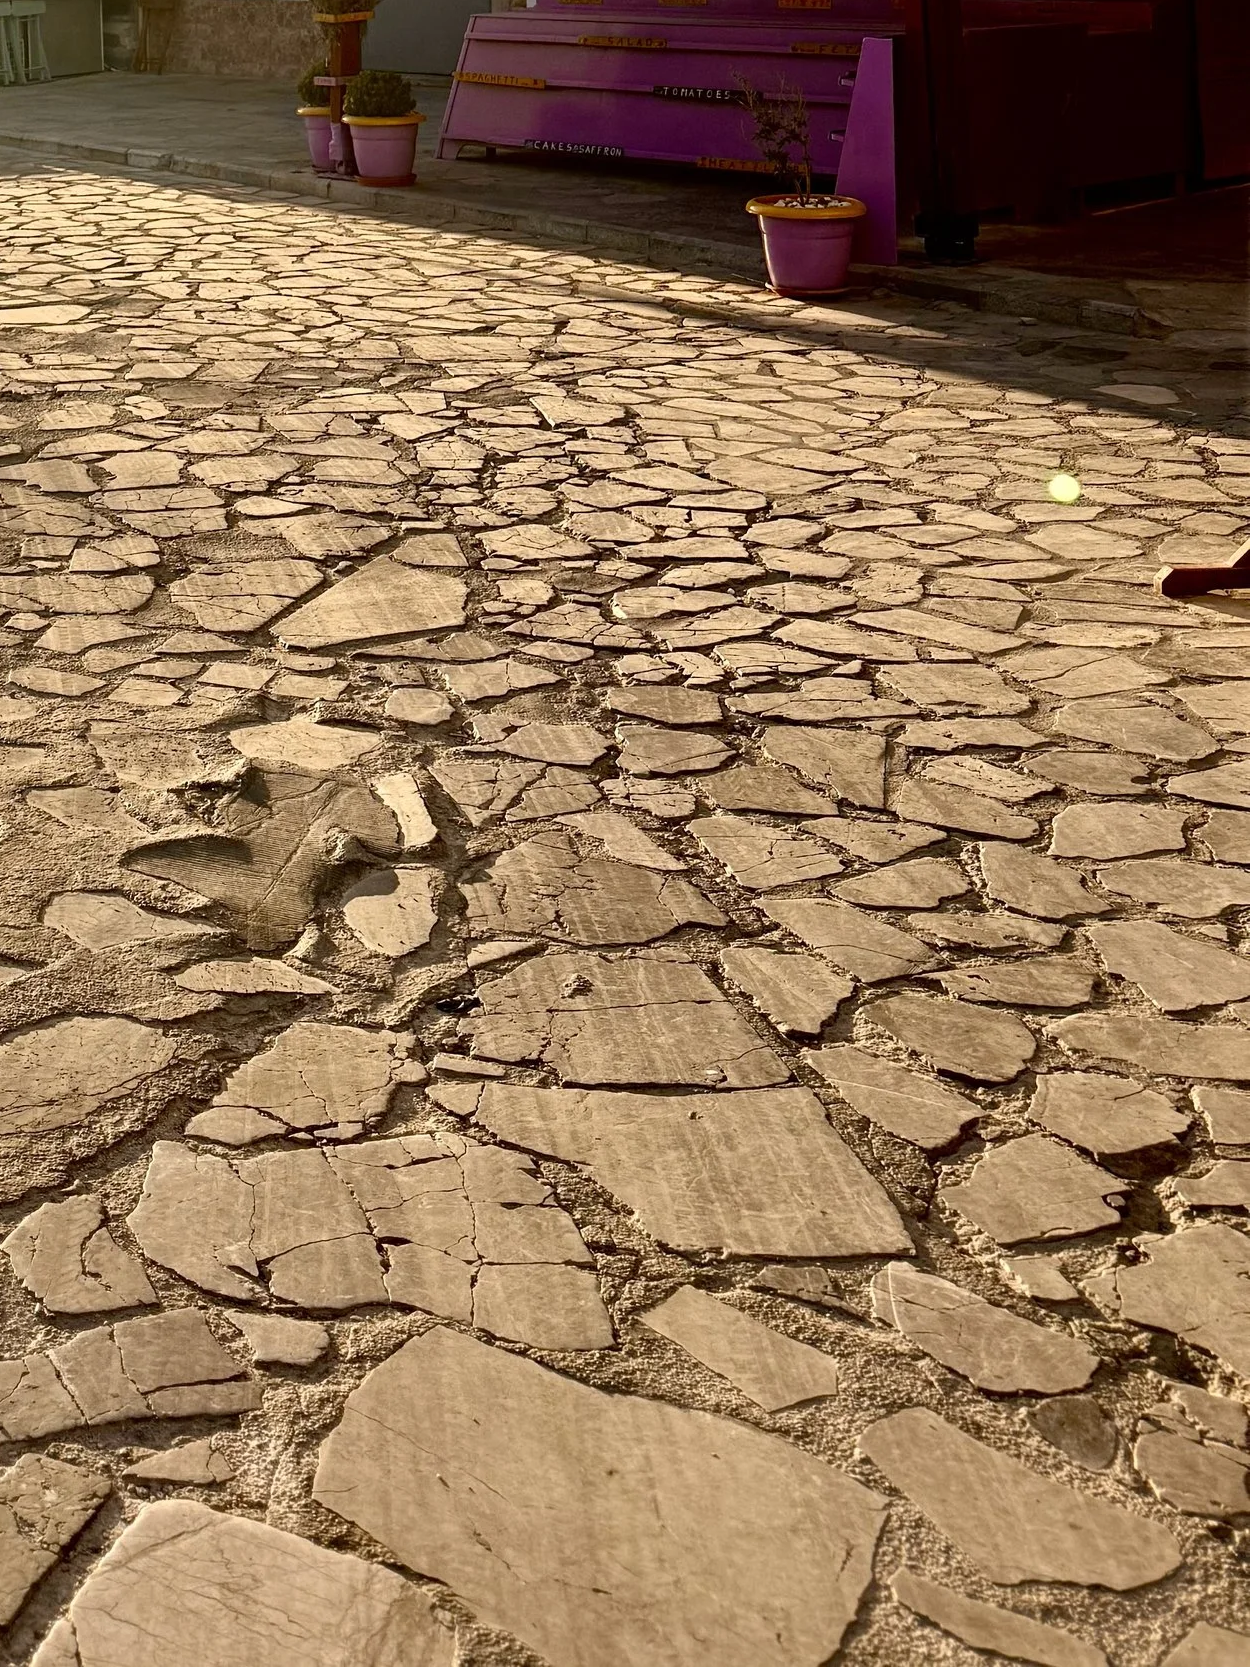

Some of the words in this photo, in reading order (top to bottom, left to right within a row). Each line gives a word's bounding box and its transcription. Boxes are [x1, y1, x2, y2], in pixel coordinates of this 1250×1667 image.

[464, 72, 519, 85] SPAGHETTI
[662, 86, 731, 101] TOMATOES
[533, 140, 573, 152] CAKES
[578, 144, 623, 157] SAFFRON
